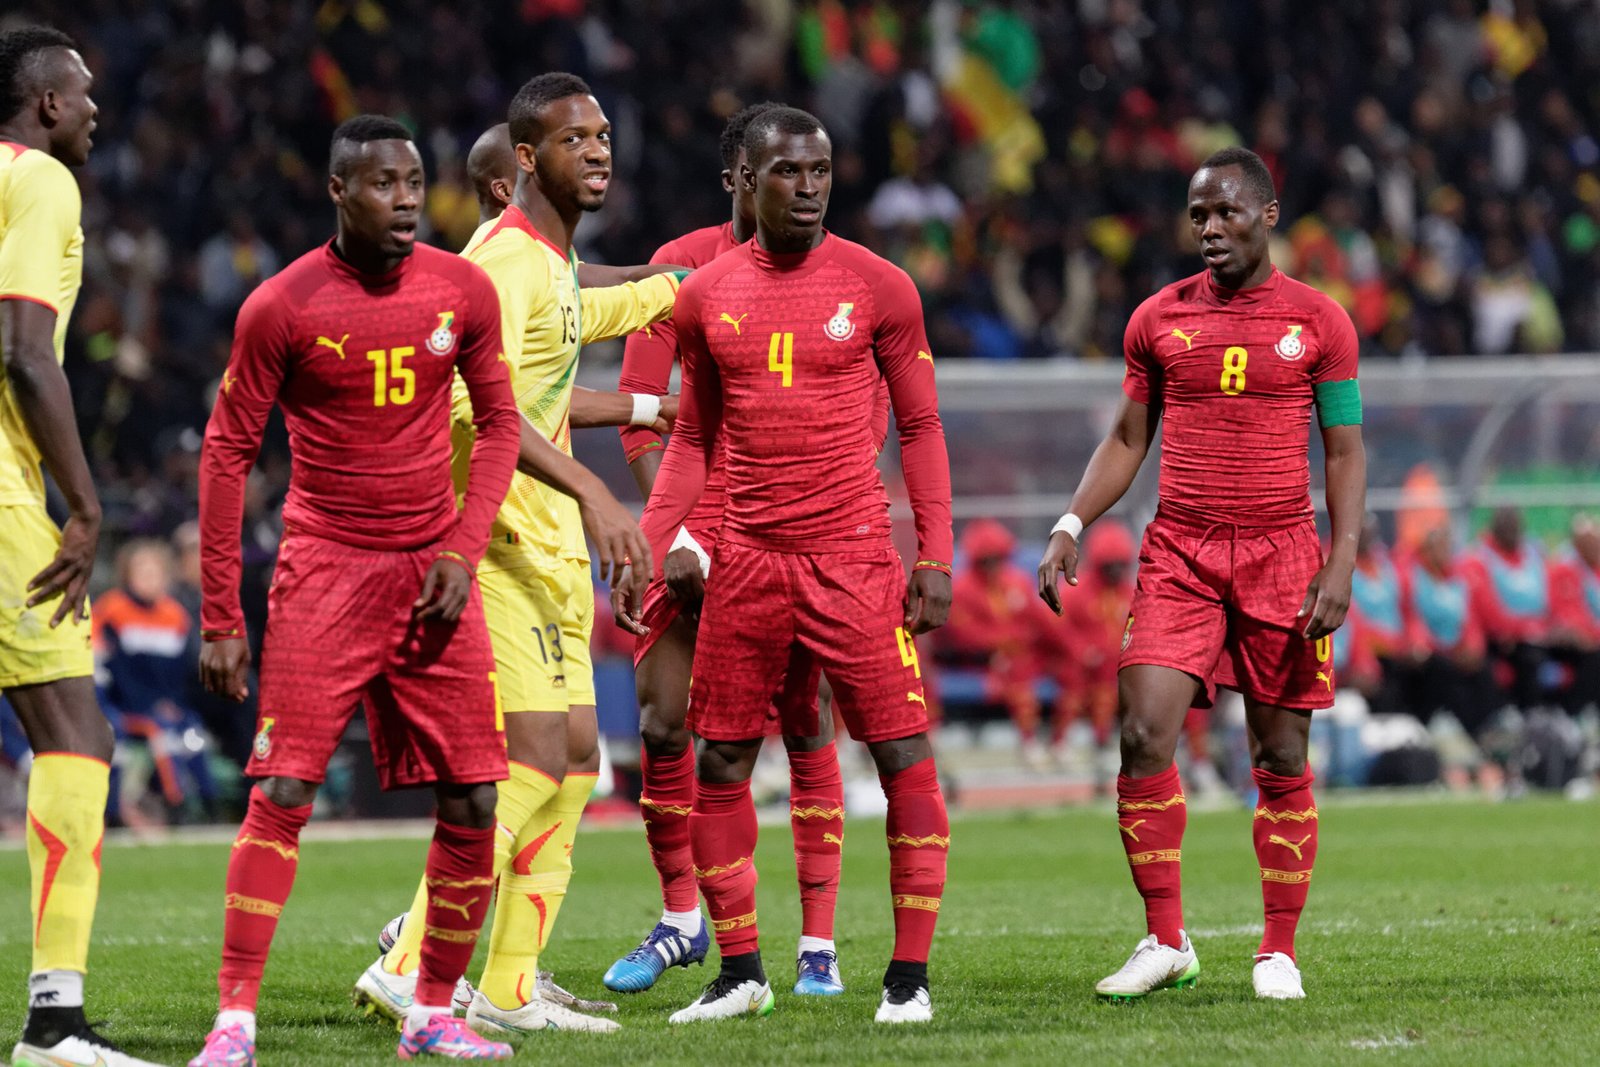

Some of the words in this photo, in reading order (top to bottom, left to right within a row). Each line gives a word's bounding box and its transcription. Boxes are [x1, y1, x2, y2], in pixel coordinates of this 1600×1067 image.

[561, 306, 576, 344] 13
[367, 346, 415, 406] 15
[768, 332, 793, 387] 4
[1221, 346, 1248, 395] 8
[531, 623, 563, 664] 13
[895, 626, 920, 679] 4
